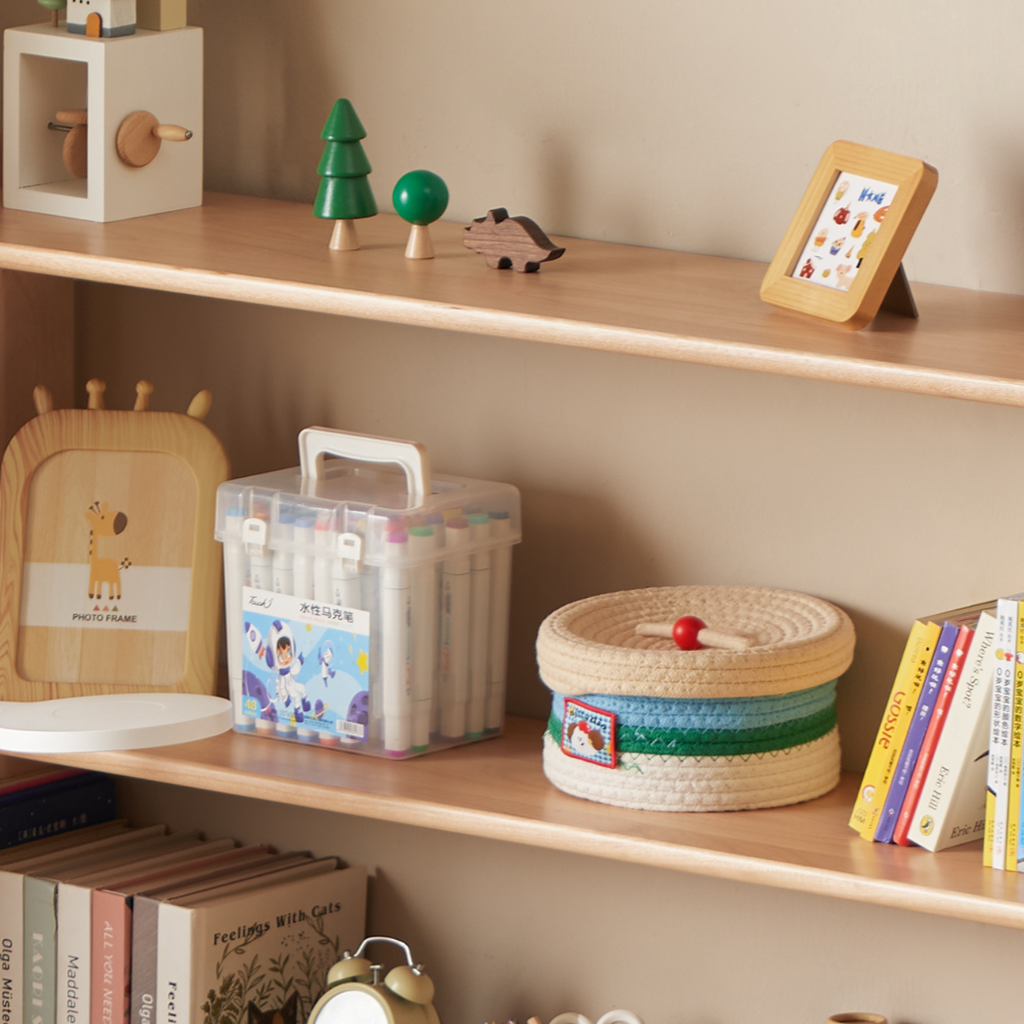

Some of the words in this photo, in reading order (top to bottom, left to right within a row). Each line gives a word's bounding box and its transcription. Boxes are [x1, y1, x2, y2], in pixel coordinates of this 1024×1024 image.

[72, 613, 104, 621] PHOTO
[105, 614, 137, 623] FRAME
[300, 602, 354, 623] 水性马克笔
[972, 630, 995, 676] Where's
[965, 677, 980, 709] Spot?
[934, 765, 950, 788] Eric
[928, 789, 943, 811] Hill
[950, 822, 972, 839] Eric
[103, 920, 114, 948] ALL
[213, 921, 271, 946] Feelings
[275, 909, 307, 928] With
[311, 901, 342, 918] Cats
[1, 938, 13, 970] Olga
[103, 953, 114, 982] YOU
[32, 932, 43, 1006] KAORI
